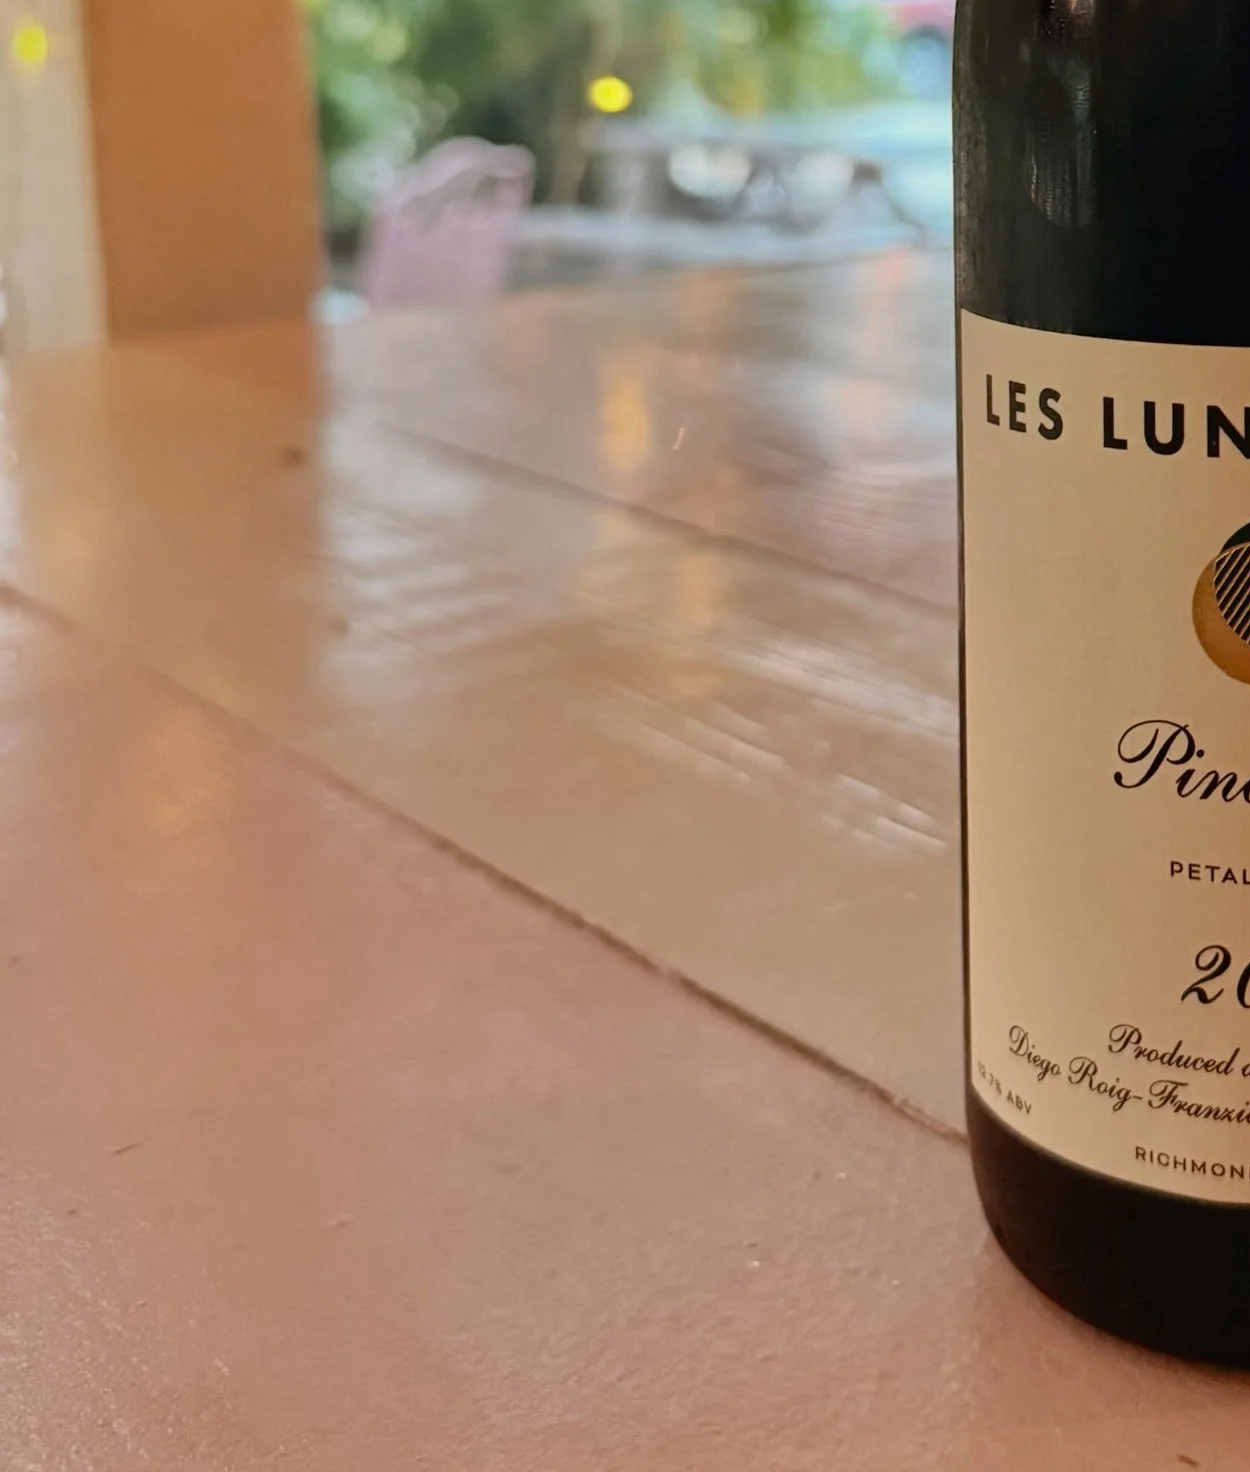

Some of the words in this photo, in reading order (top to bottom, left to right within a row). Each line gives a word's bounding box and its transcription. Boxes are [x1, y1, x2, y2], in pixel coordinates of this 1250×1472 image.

[986, 373, 1064, 440] LES
[1008, 1025, 1062, 1081] Diego
[1108, 1024, 1240, 1075] Produced
[1006, 1089, 1033, 1116] ABV
